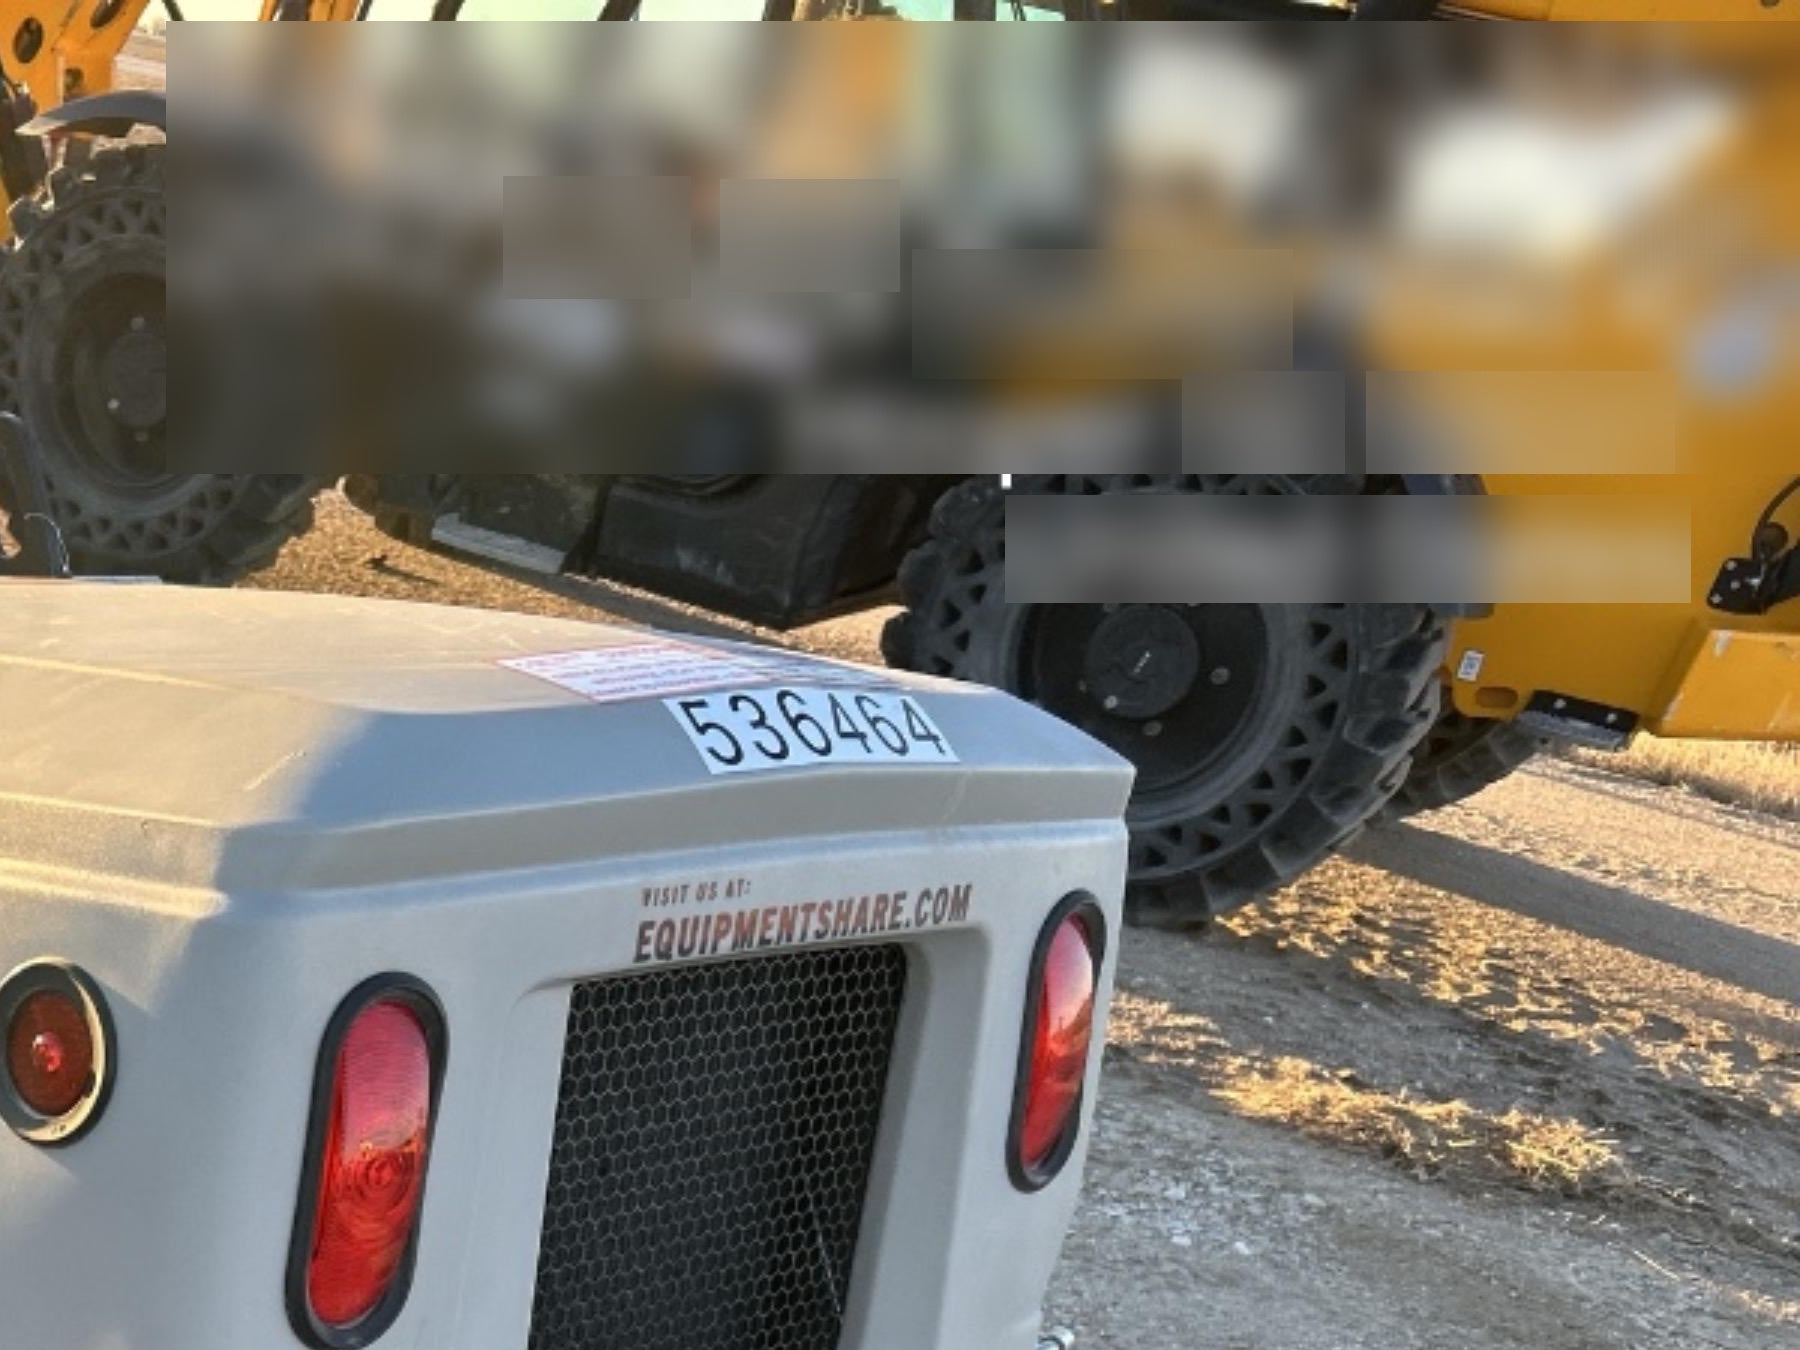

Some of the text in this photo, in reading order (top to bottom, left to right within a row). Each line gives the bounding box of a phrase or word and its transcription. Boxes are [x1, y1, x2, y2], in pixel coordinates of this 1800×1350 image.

[676, 688, 946, 766] 536464
[633, 882, 973, 964] EQUIPMENTSHARE.COM
[642, 884, 691, 907] VISIT
[698, 881, 718, 901] US
